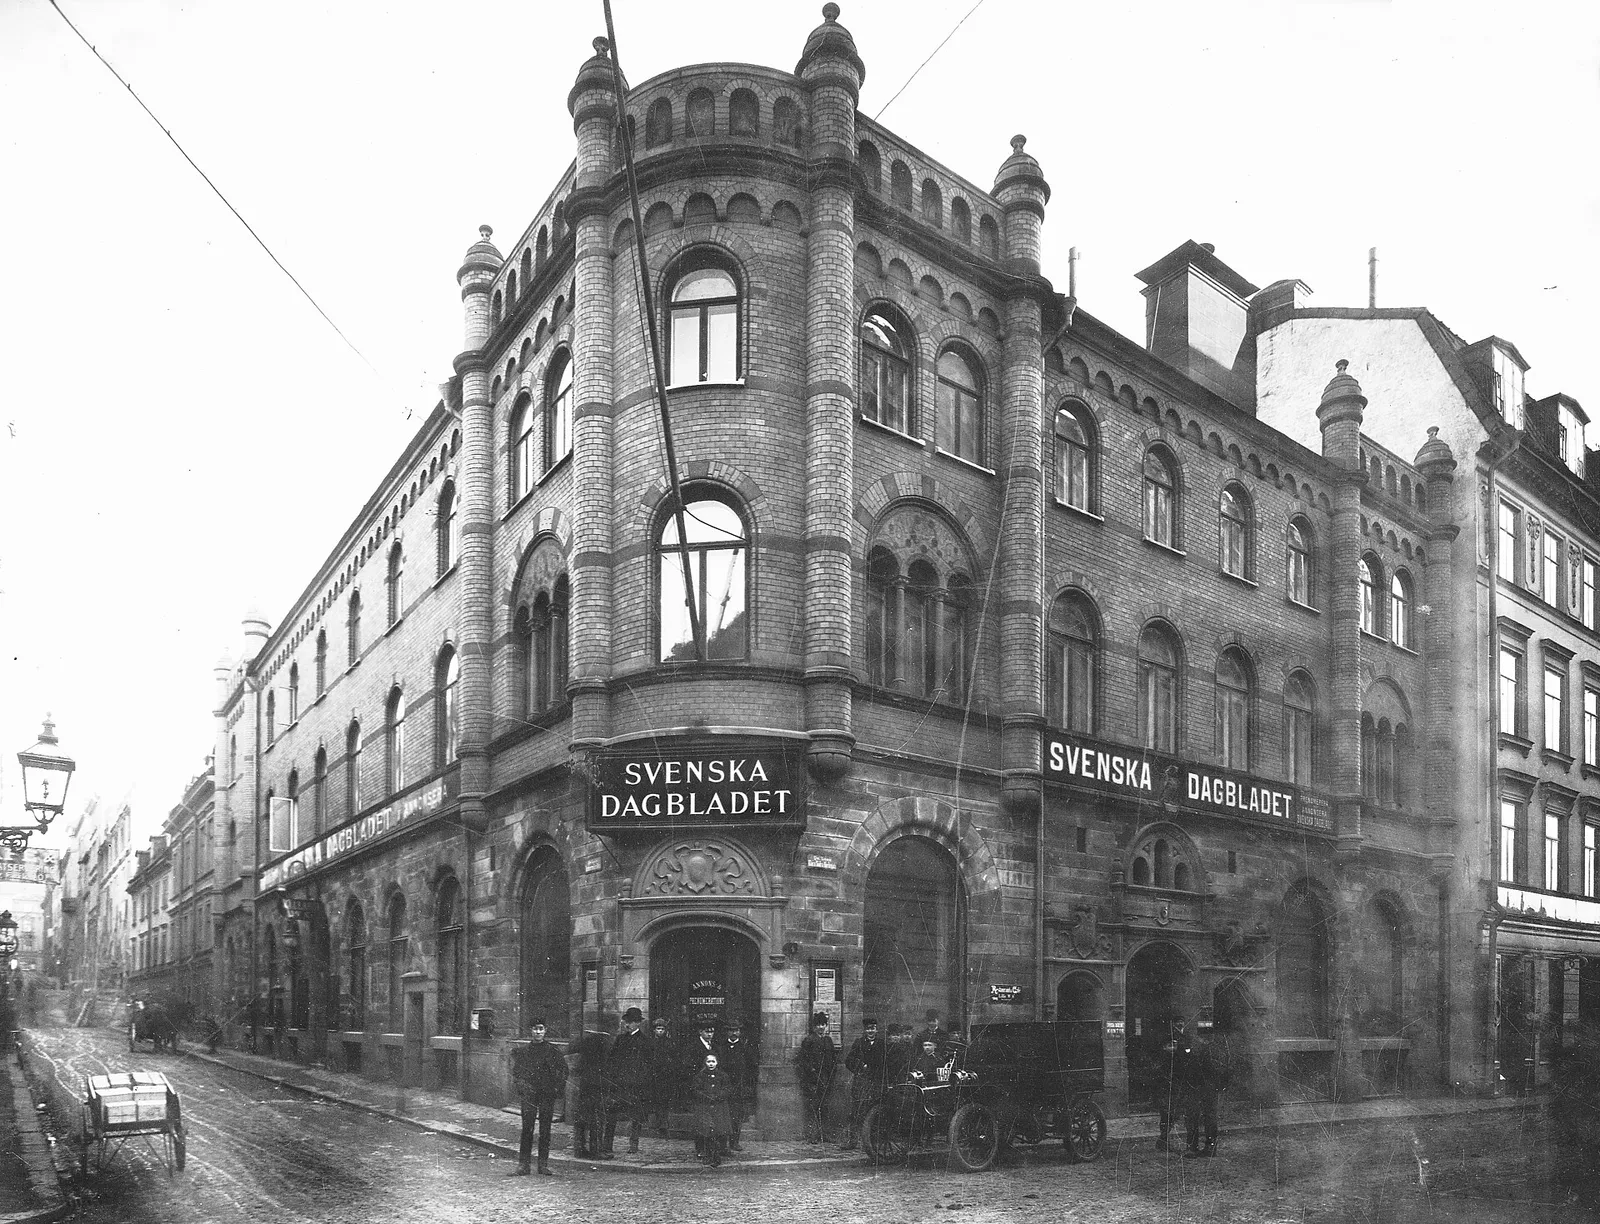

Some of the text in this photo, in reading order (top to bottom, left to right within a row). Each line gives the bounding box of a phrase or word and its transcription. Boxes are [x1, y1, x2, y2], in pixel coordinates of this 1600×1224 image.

[624, 759, 769, 786] SVENSKA
[1049, 741, 1153, 791] SVENSKA
[601, 789, 792, 818] DAGBLADET
[1187, 771, 1293, 819] DAGBLADET
